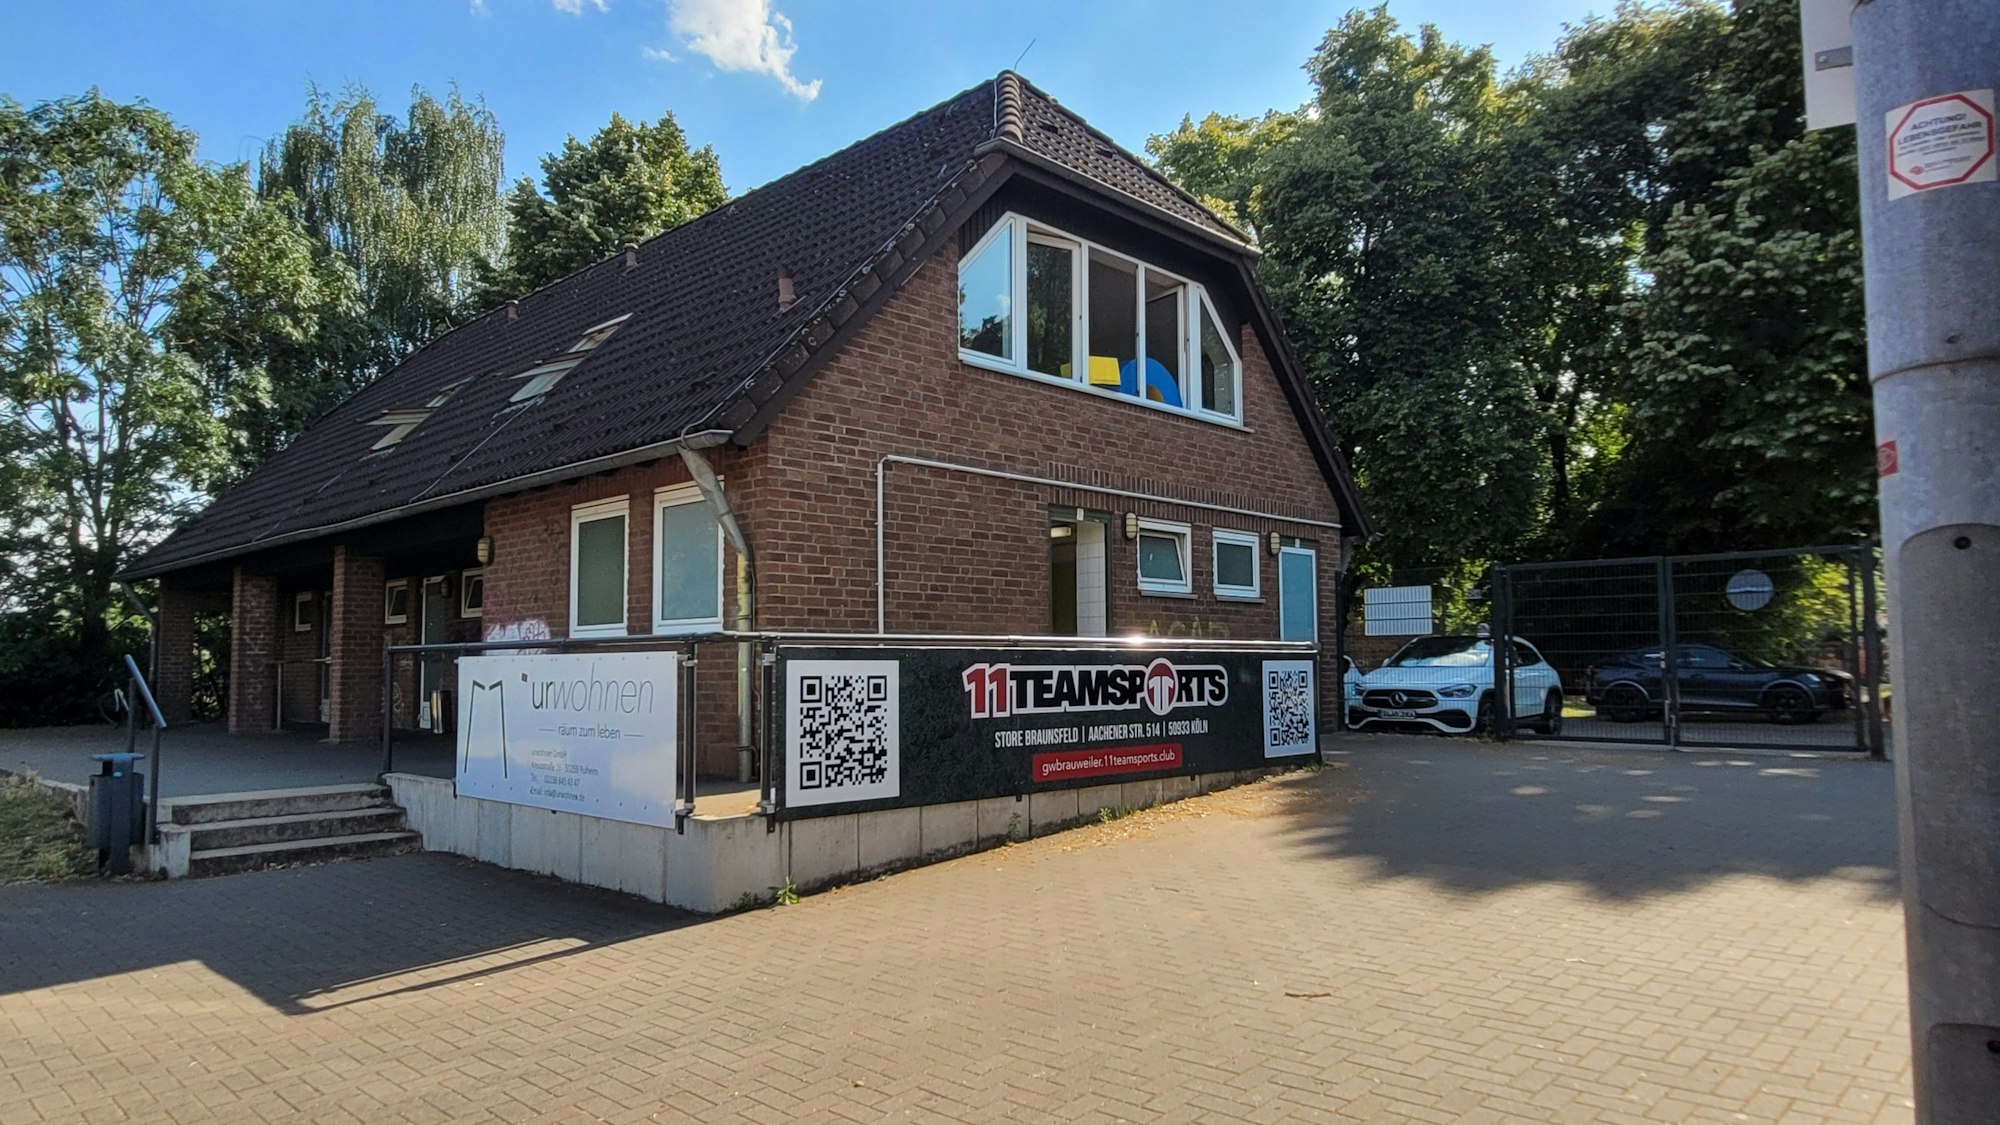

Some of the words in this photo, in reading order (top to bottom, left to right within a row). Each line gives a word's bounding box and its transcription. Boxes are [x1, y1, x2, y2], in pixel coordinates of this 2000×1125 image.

[531, 662, 654, 714] urwohnen
[558, 725, 578, 736] raum
[579, 727, 596, 737] zum
[597, 723, 621, 739] leben
[994, 730, 1024, 748] STORE
[1025, 727, 1079, 746] BRAUNSFELD
[1088, 724, 1128, 741] AACHENER
[1129, 723, 1145, 739] STR.
[1146, 722, 1161, 737] 514
[1168, 720, 1190, 736] 50933
[1191, 717, 1209, 734] KÖLN
[1041, 749, 1176, 776] gwbrauweiler.11teamsports.club
